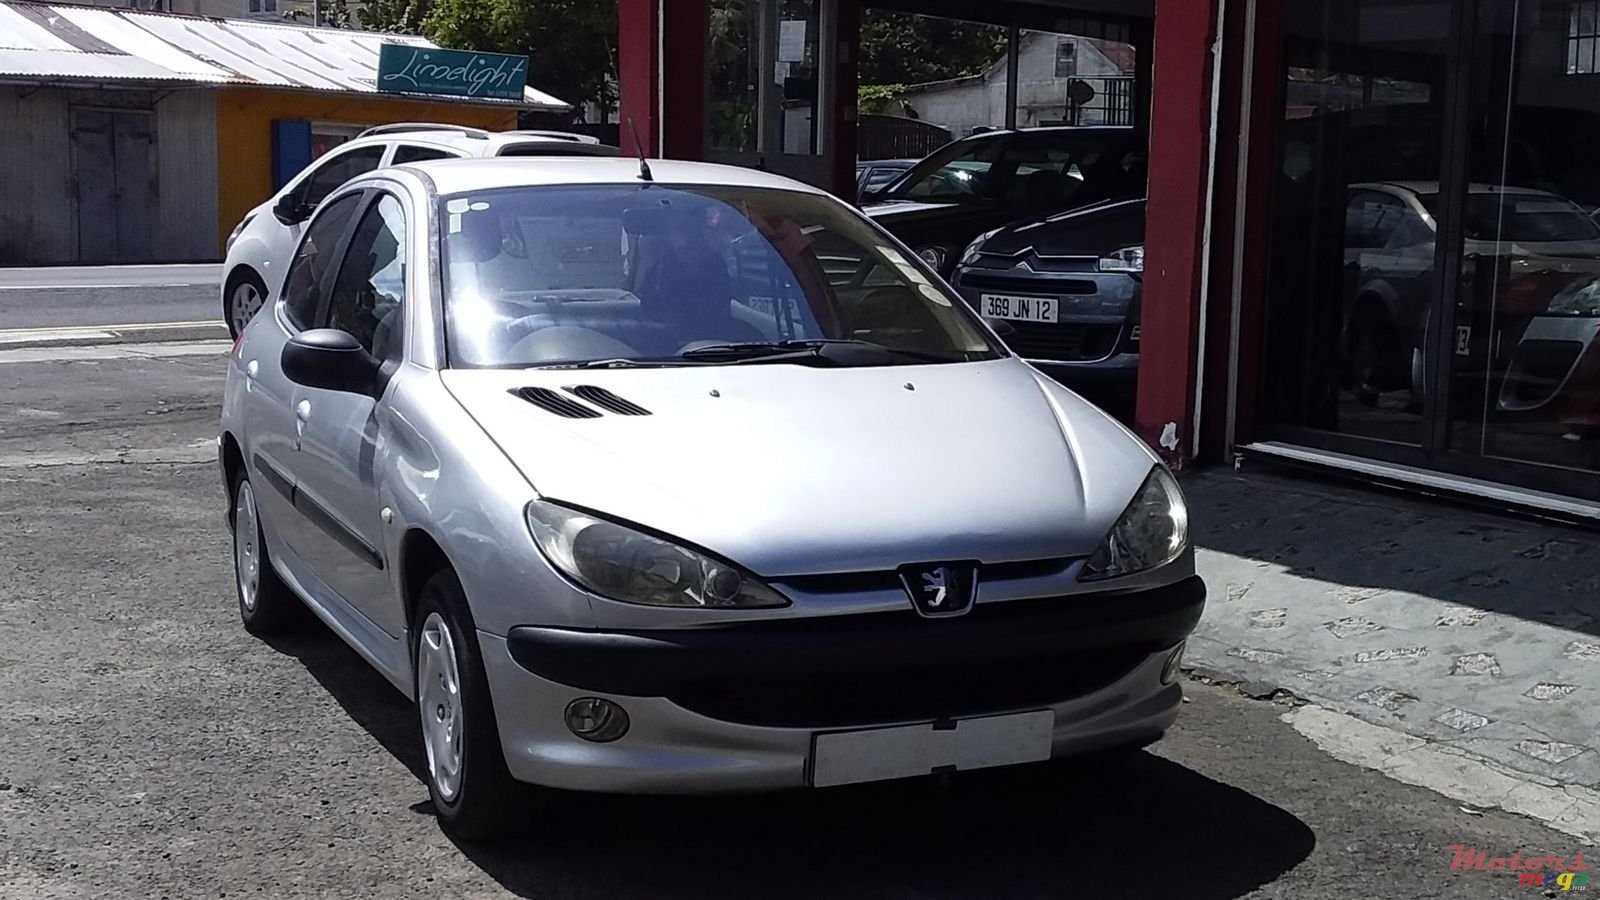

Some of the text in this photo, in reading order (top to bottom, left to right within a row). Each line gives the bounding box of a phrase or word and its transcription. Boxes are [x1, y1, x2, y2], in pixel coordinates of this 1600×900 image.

[383, 50, 525, 95] Limelight
[987, 297, 1051, 320] 369 JN 12
